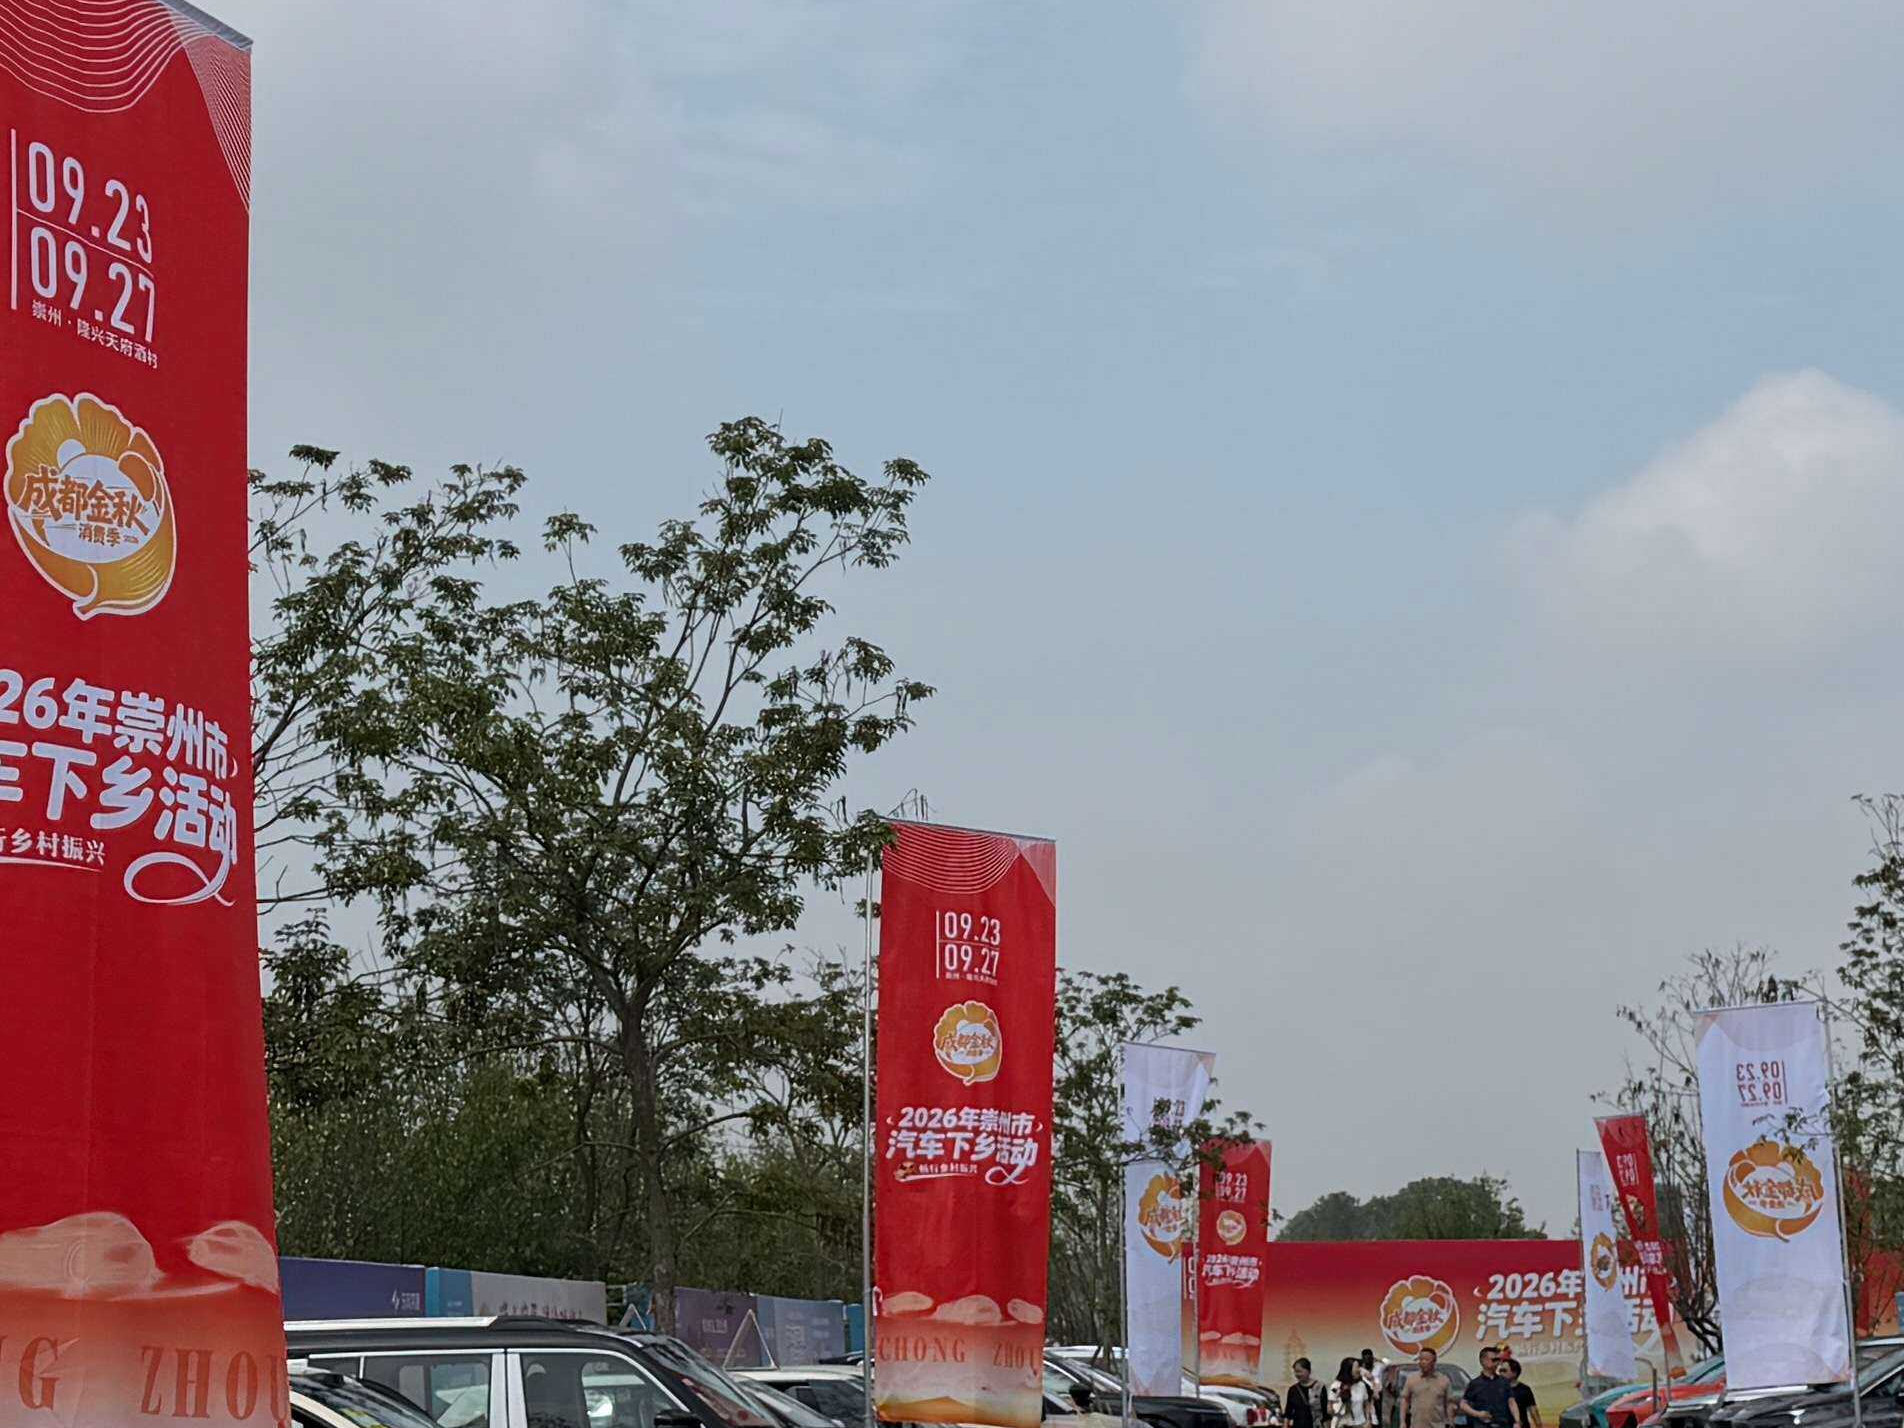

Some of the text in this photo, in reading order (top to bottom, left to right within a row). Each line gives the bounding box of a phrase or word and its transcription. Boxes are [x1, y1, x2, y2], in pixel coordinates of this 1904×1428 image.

[28, 141, 153, 264] 09.23
[30, 226, 156, 344] 09.27
[16, 463, 150, 536] 成都金秋
[944, 911, 1001, 946] 09.23
[944, 943, 1000, 978] 09.27
[898, 1105, 1036, 1137] 2026年崇州市
[885, 1129, 1039, 1167] 汽车下乡活动
[876, 1335, 966, 1364] CHONG
